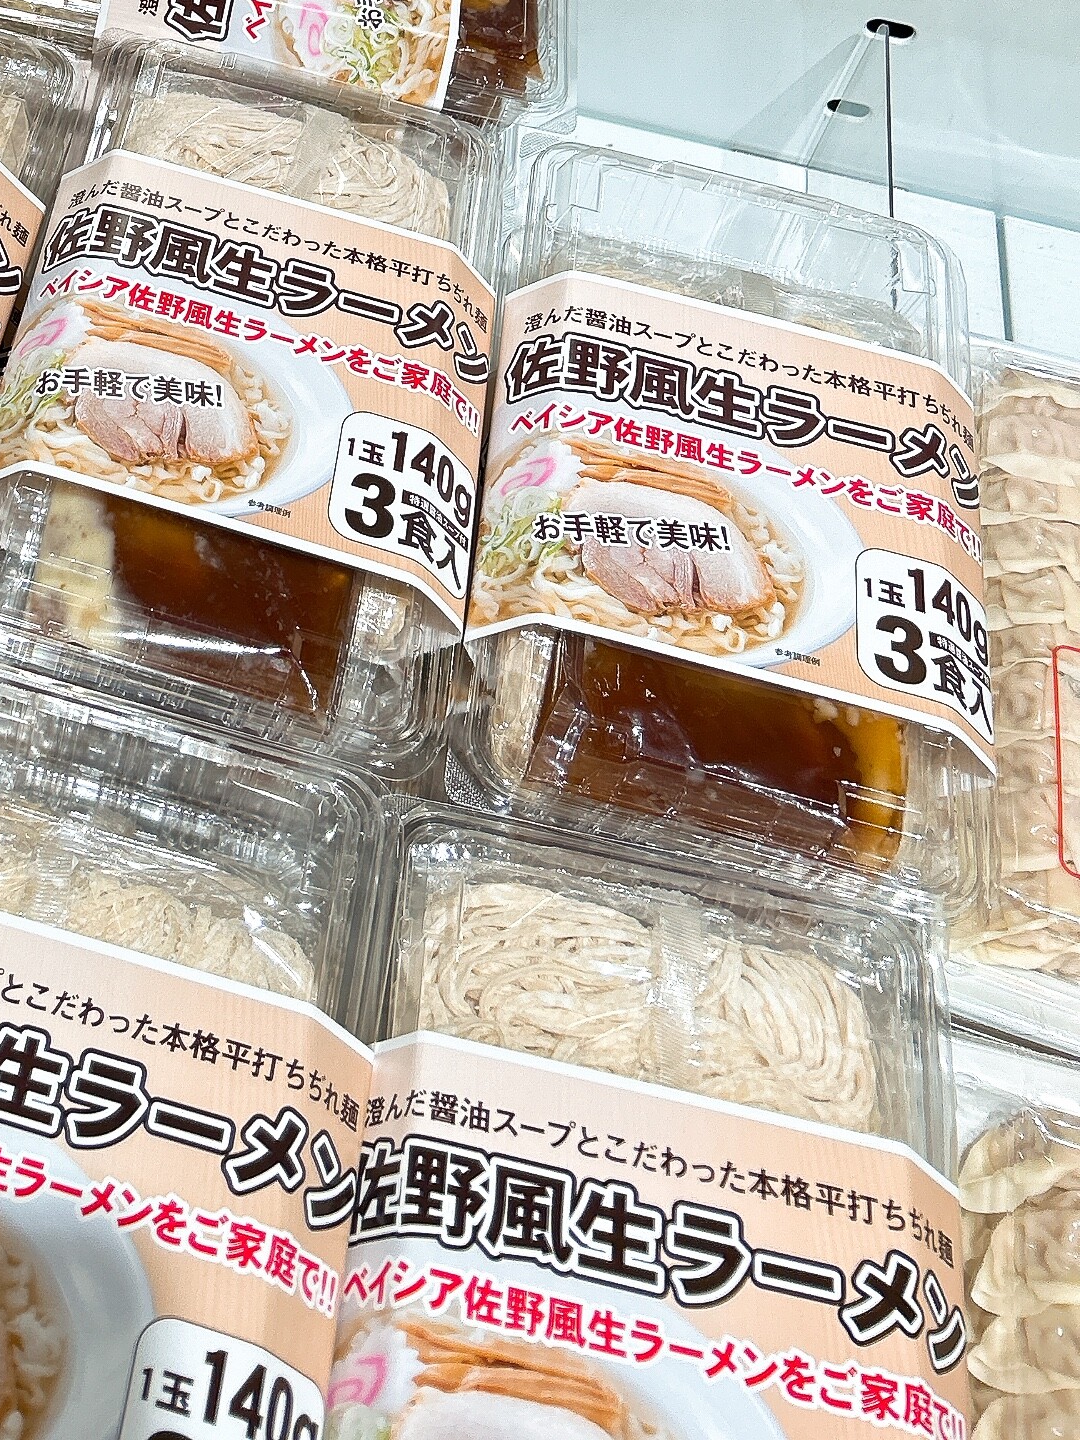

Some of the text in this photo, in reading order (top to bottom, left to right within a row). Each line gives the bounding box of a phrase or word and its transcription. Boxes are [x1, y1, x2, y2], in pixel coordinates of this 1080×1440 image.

[42, 203, 490, 385] 佐野風生ラーメン
[35, 368, 224, 409] お手軽で美味!
[505, 333, 980, 511] 佐野風生ラーメン
[343, 473, 463, 593] 3食入
[533, 514, 732, 554] お手軽で美味!
[874, 614, 993, 737] 3食入
[348, 1135, 967, 1376] 佐野風生ラーメン
